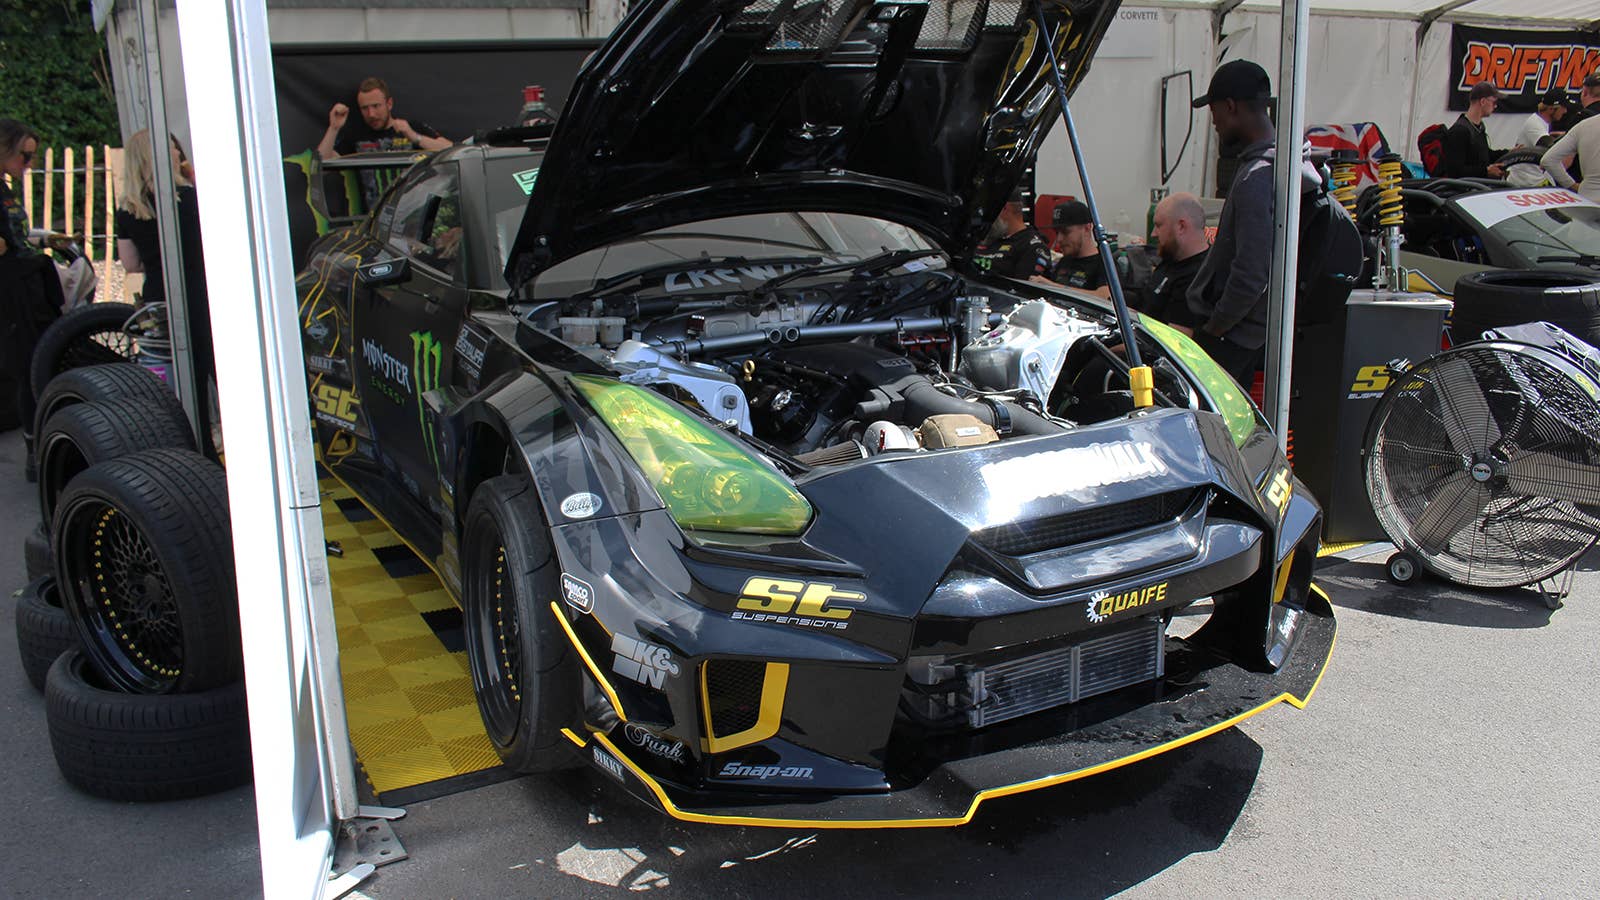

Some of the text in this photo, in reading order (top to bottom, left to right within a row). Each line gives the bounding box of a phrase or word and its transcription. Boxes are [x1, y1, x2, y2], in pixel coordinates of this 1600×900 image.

[1120, 11, 1159, 20] CORVETTE
[1506, 191, 1582, 207] SONAX
[362, 338, 412, 394] MONSTER
[563, 578, 589, 598] SAMCO
[1100, 582, 1168, 615] QUAIFE
[731, 611, 848, 629] SUSPENSIONS
[624, 722, 684, 758] Funk
[592, 746, 624, 777] SIKKY
[719, 761, 814, 780] Snap-on
